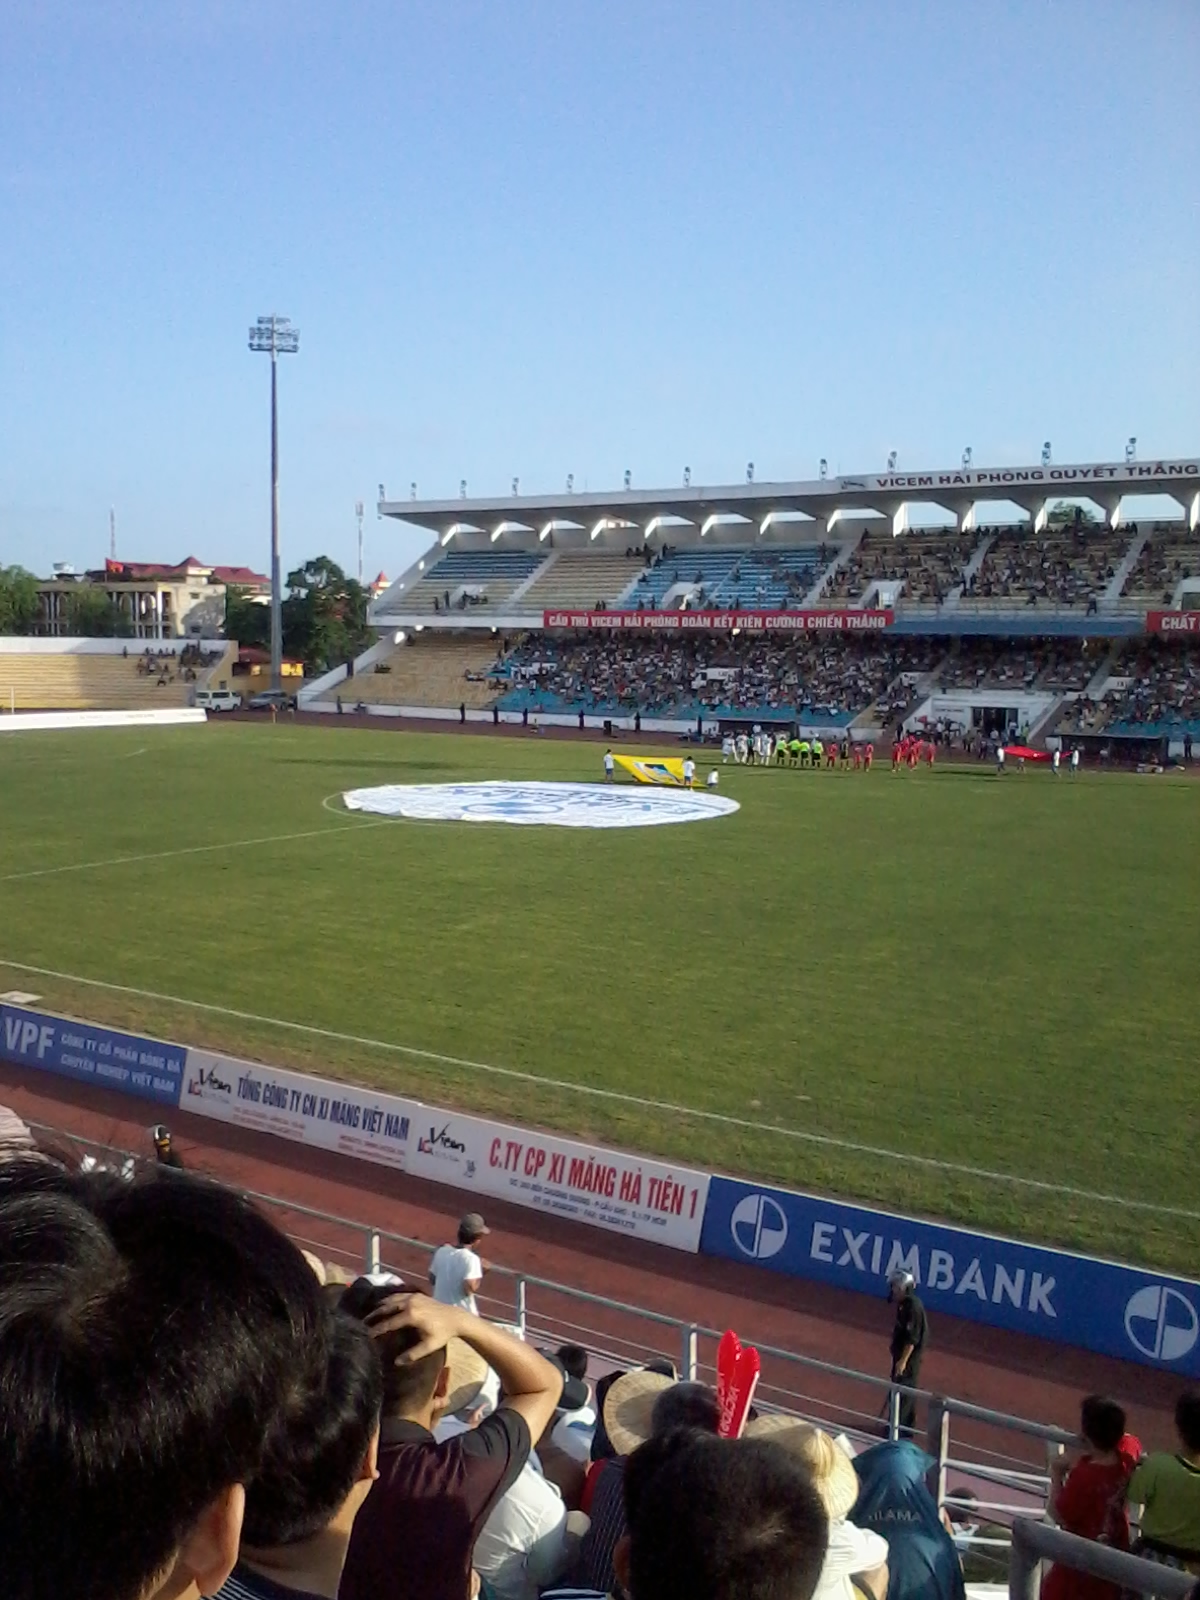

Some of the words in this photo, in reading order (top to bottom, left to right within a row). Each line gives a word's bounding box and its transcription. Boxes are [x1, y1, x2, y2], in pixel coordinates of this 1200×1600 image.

[876, 476, 933, 488] VICEM
[5, 1016, 55, 1059] VPF
[289, 1089, 302, 1113] TY
[384, 1113, 410, 1141] NAM
[489, 1137, 523, 1173] C.TY
[524, 1146, 546, 1178] CP
[547, 1152, 567, 1184] XI
[646, 1174, 687, 1216] TIÊN
[689, 1188, 699, 1220] 1
[810, 1221, 1057, 1318] EXIMBANK
